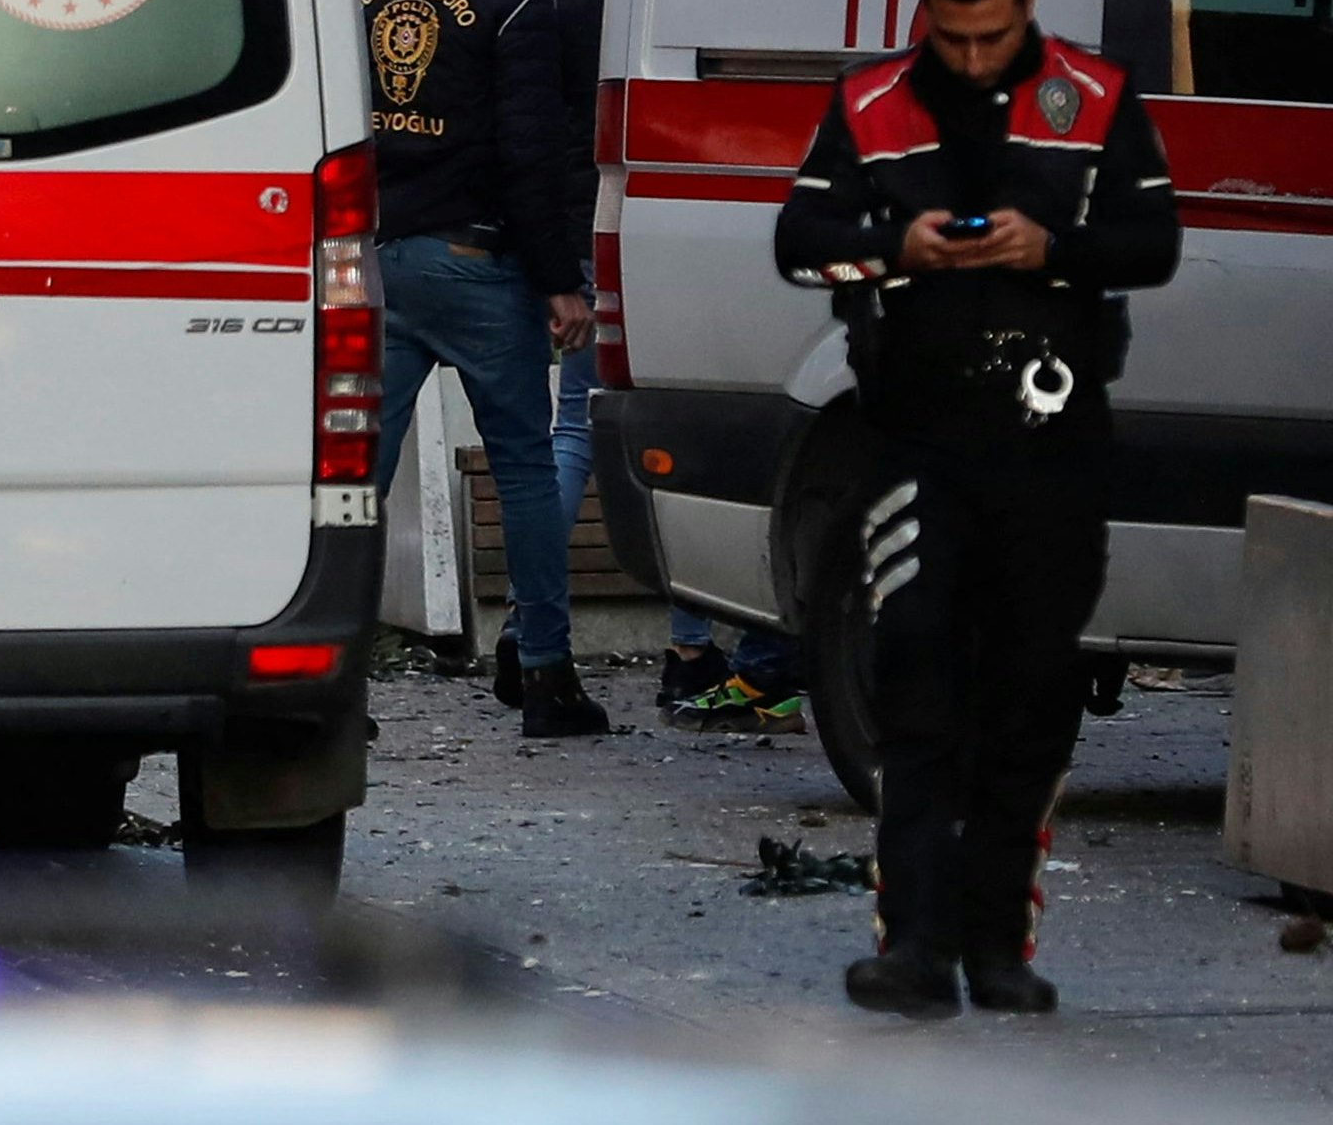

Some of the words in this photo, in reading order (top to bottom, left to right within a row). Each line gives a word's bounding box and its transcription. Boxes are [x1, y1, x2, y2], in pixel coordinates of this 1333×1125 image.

[371, 110, 444, 135] EYOĞLU
[185, 318, 245, 334] 316
[252, 318, 307, 334] CDI
